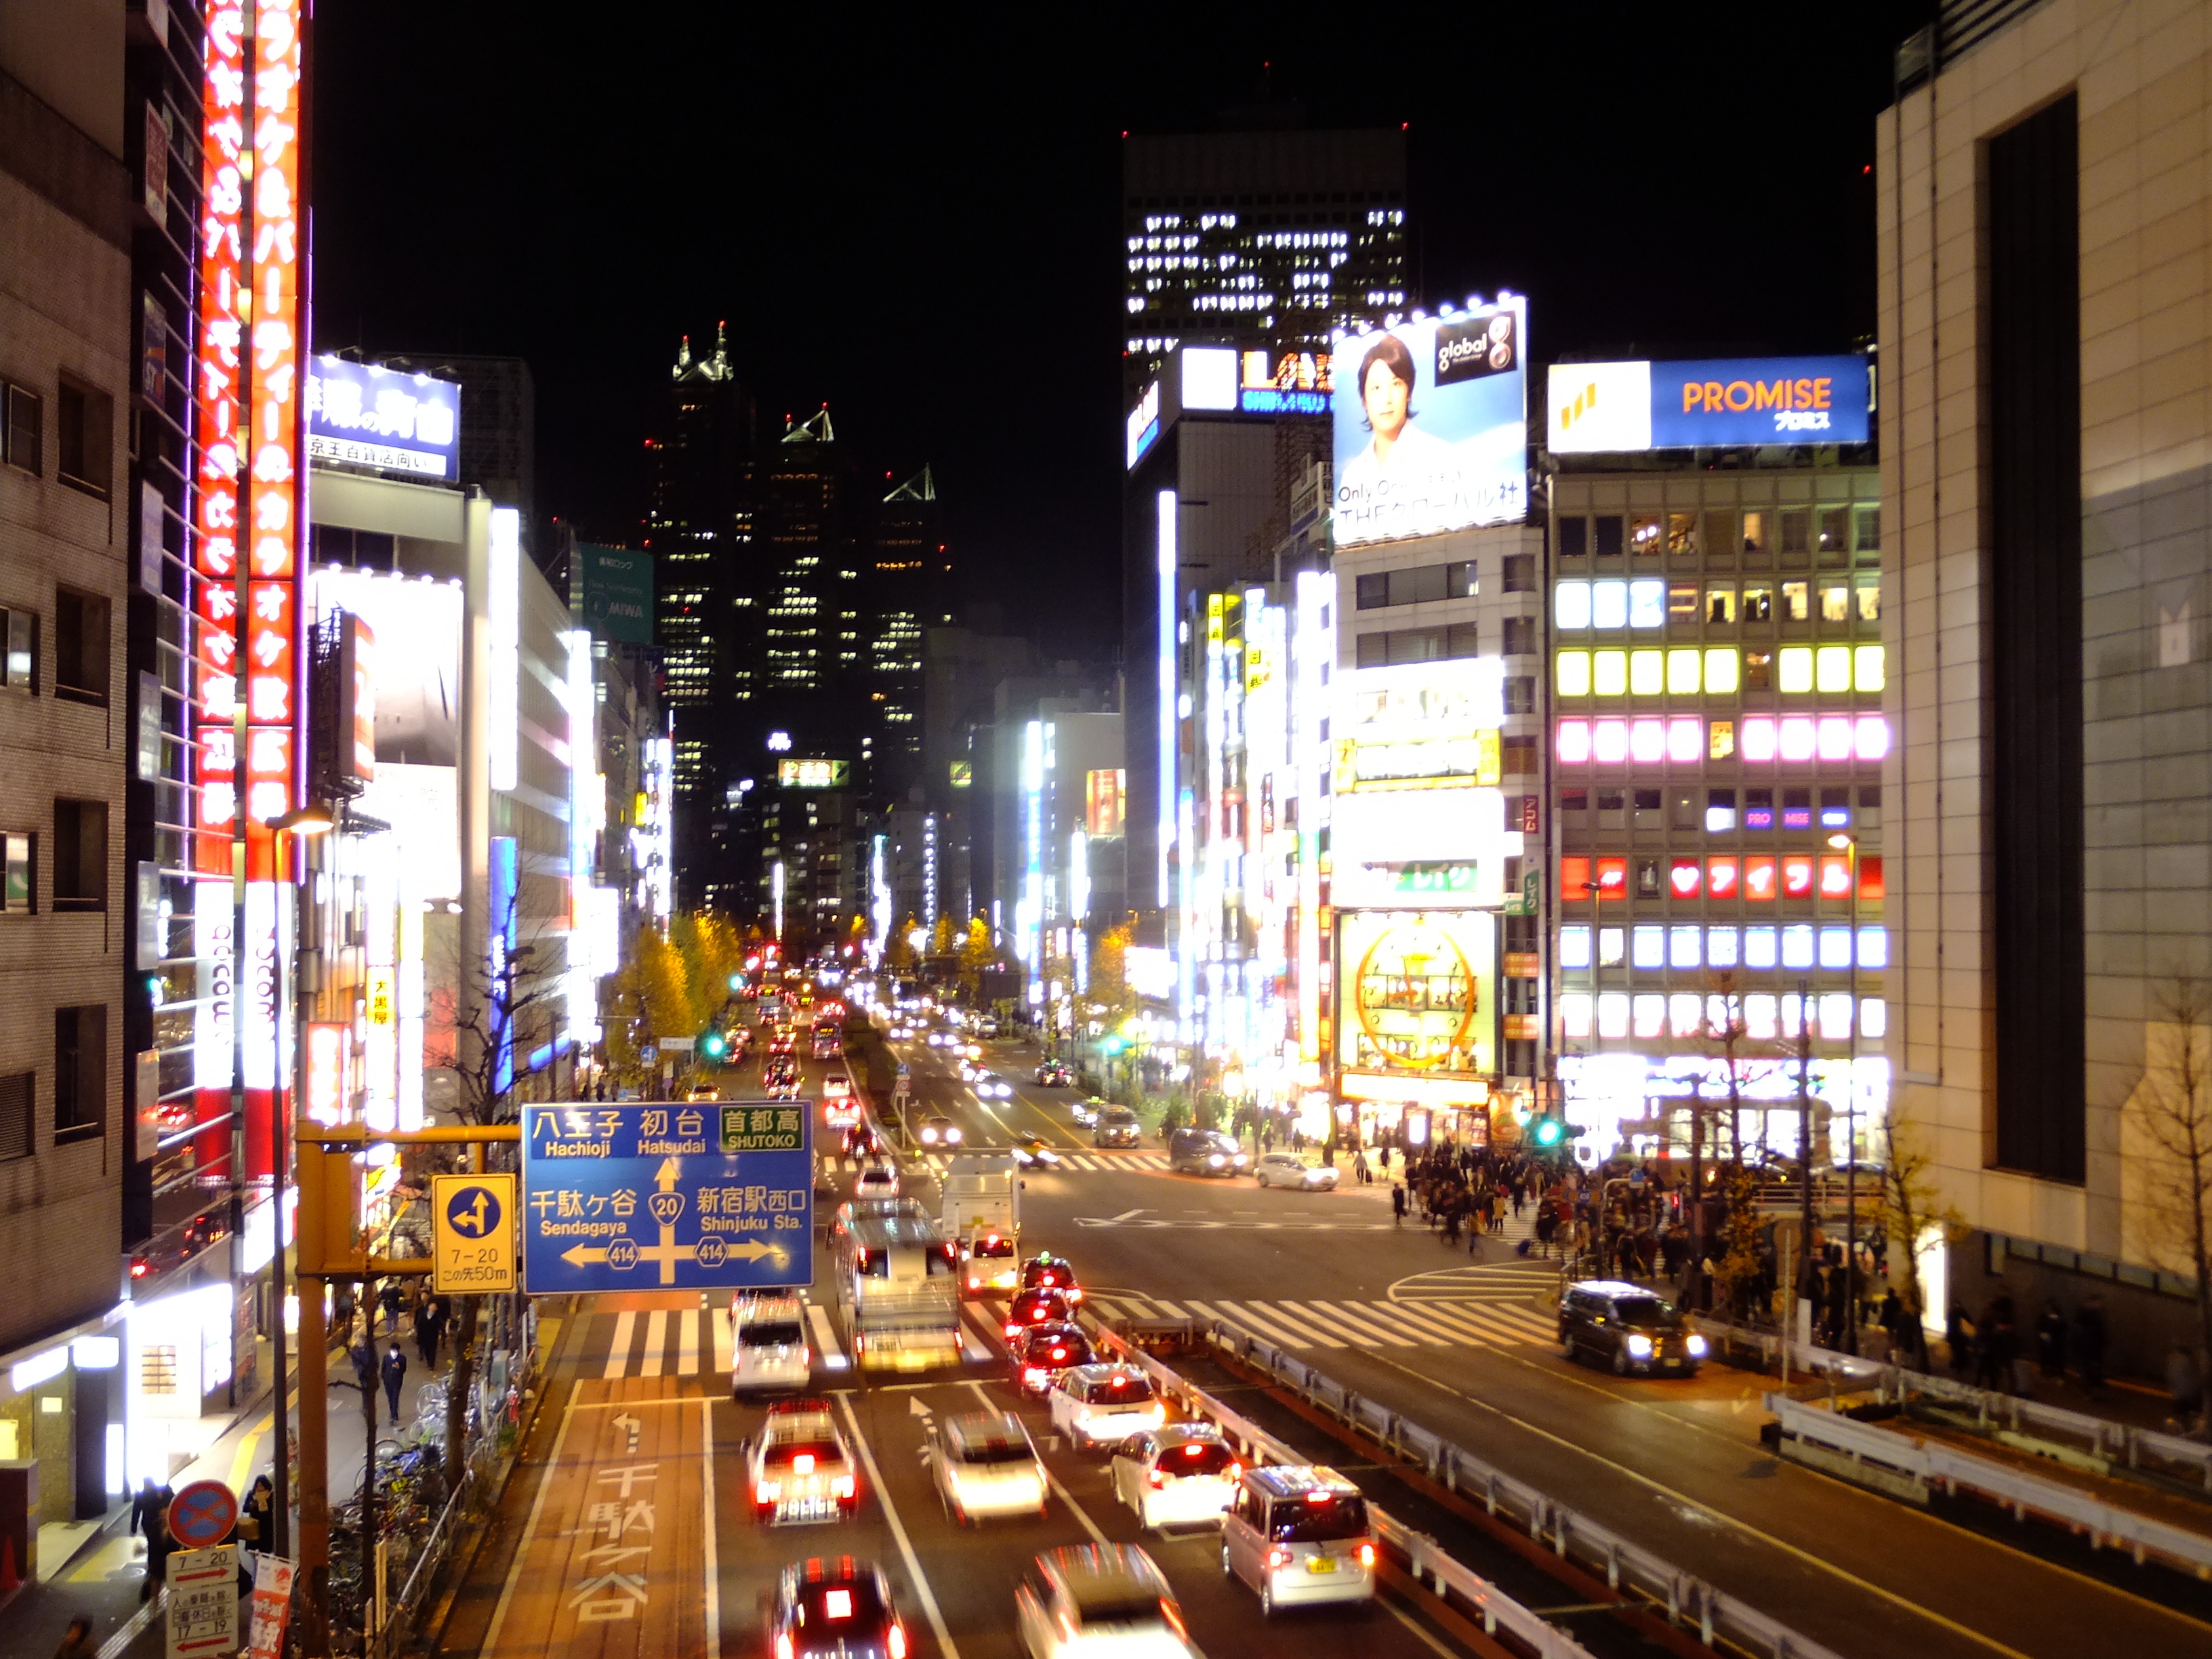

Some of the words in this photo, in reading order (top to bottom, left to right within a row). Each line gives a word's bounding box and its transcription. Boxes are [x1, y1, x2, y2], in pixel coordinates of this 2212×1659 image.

[1439, 333, 1487, 373] global
[1683, 377, 1832, 413] PROMISE
[1774, 410, 1830, 431] プロミス
[310, 438, 427, 469] 京王百貨店向い
[1338, 483, 1372, 503] Only
[609, 601, 643, 618] MIWA
[1525, 798, 1537, 832] アコム
[1747, 813, 1771, 825] PRO
[1784, 813, 1809, 824] MISE
[1527, 878, 1537, 909] レイク
[373, 980, 388, 1025] 大黒屋
[531, 1110, 624, 1139] 八王子
[640, 1109, 705, 1137] 初台
[724, 1109, 800, 1133] 首都高
[546, 1140, 611, 1158] Hachioji
[637, 1139, 706, 1156] Hatsudai
[728, 1135, 796, 1149] SHUTOKO
[656, 1197, 678, 1216] 20
[697, 1186, 806, 1214] 新宿駅西口
[540, 1220, 627, 1237] Sendagaya
[701, 1216, 769, 1234] Shinjuku
[774, 1215, 804, 1230] Sta.
[610, 1248, 636, 1263] 414
[699, 1244, 724, 1261] 414
[443, 1266, 508, 1282] この先50m
[210, 1552, 228, 1564] 20
[178, 1626, 190, 1639] 17
[213, 1620, 227, 1633] 19
